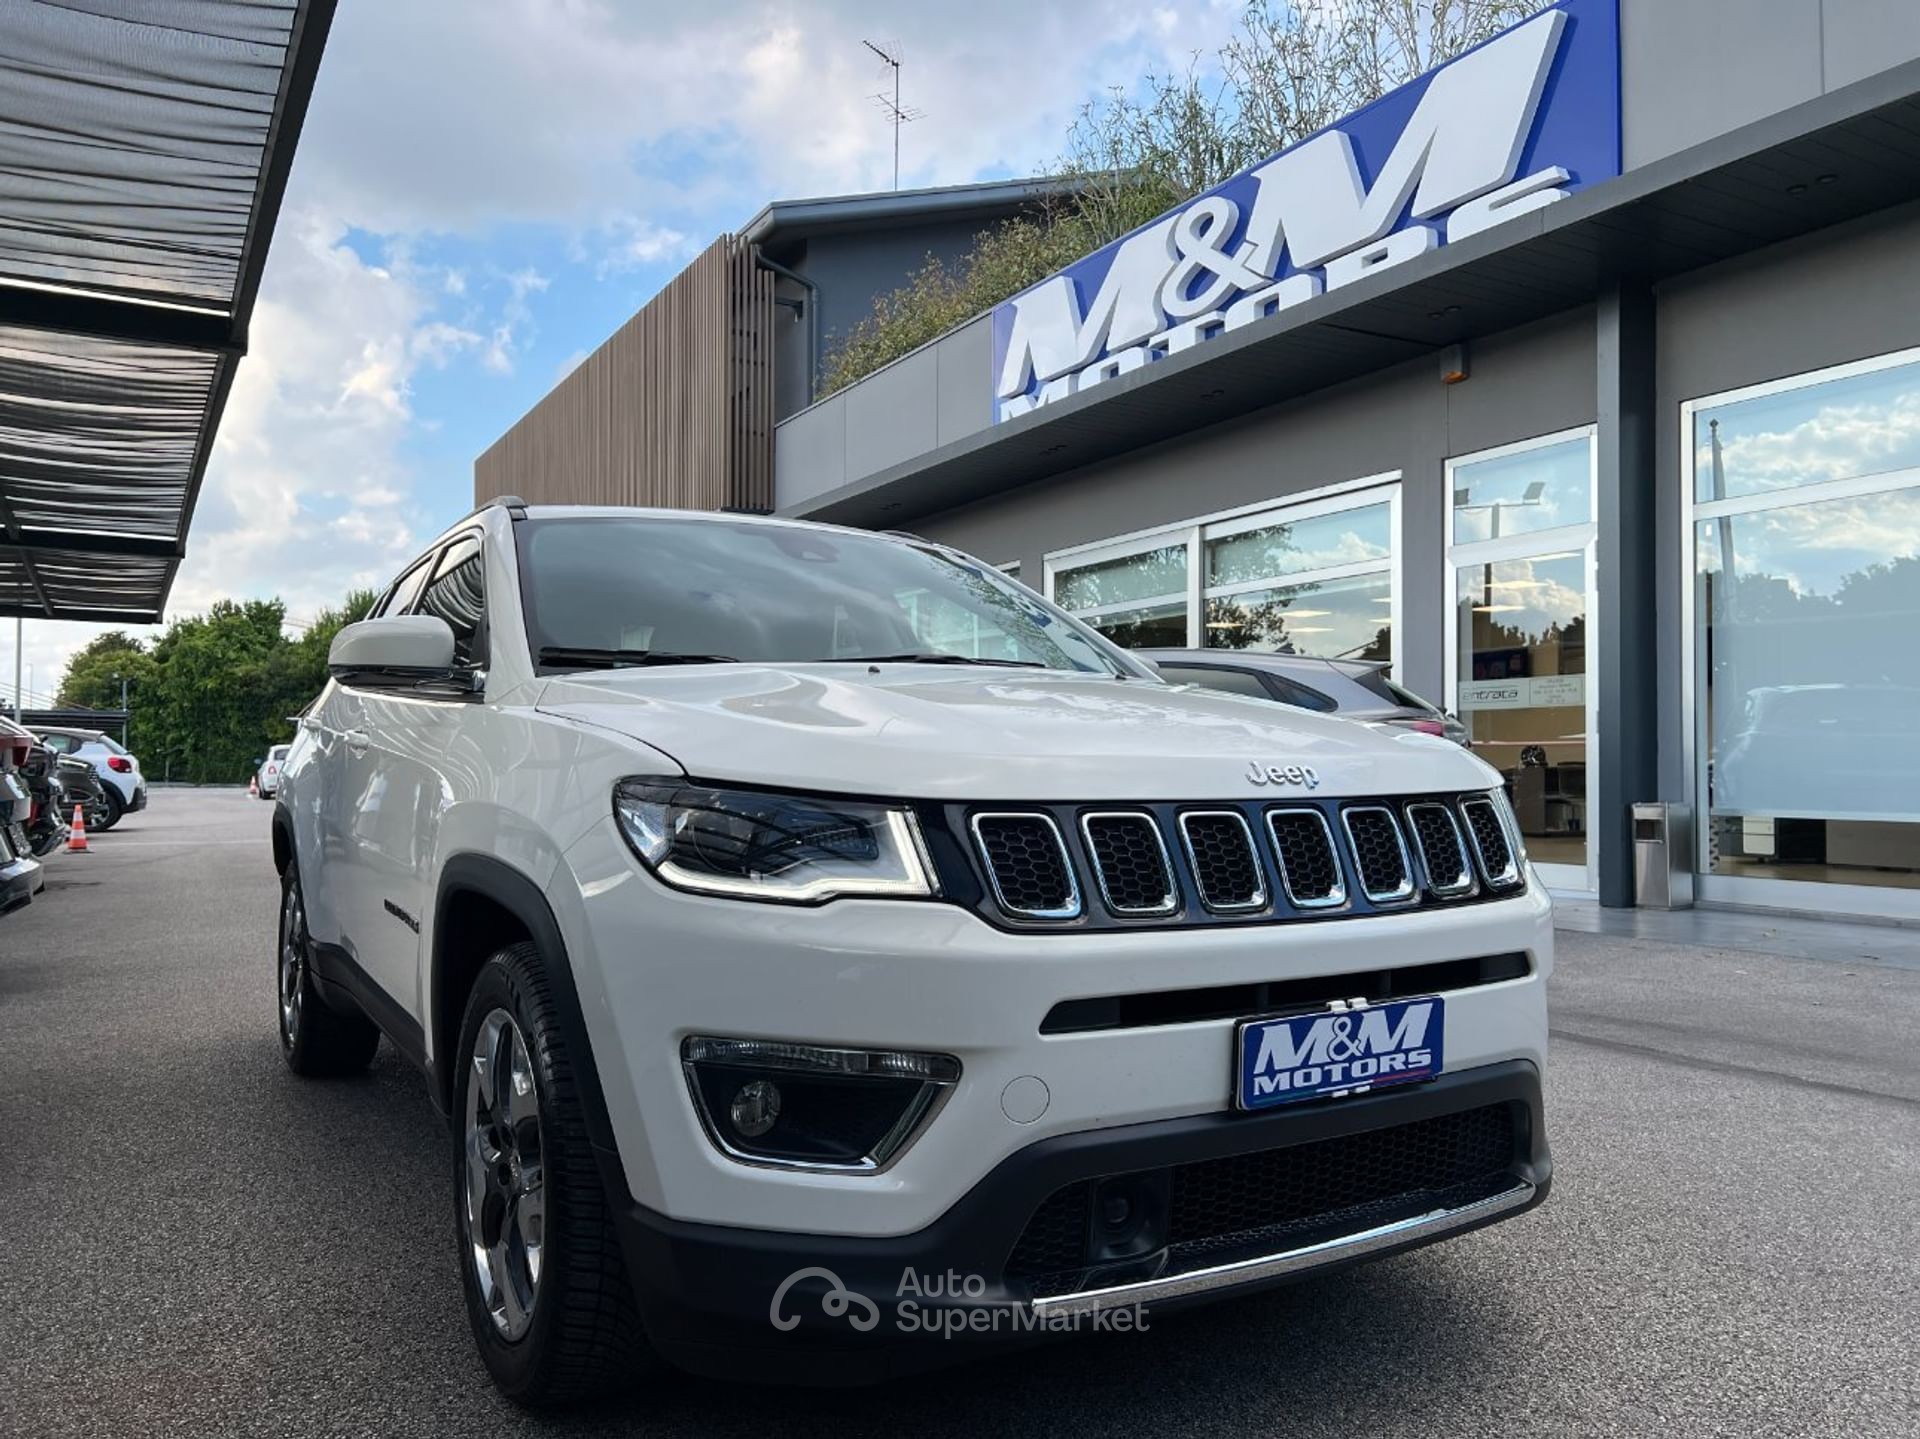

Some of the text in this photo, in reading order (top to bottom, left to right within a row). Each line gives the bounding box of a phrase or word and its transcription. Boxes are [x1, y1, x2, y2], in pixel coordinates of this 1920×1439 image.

[998, 8, 1568, 398] M&M
[1245, 760, 1320, 790] Jeep
[1253, 1002, 1434, 1074] M&M
[1253, 1048, 1432, 1096] MOTORS
